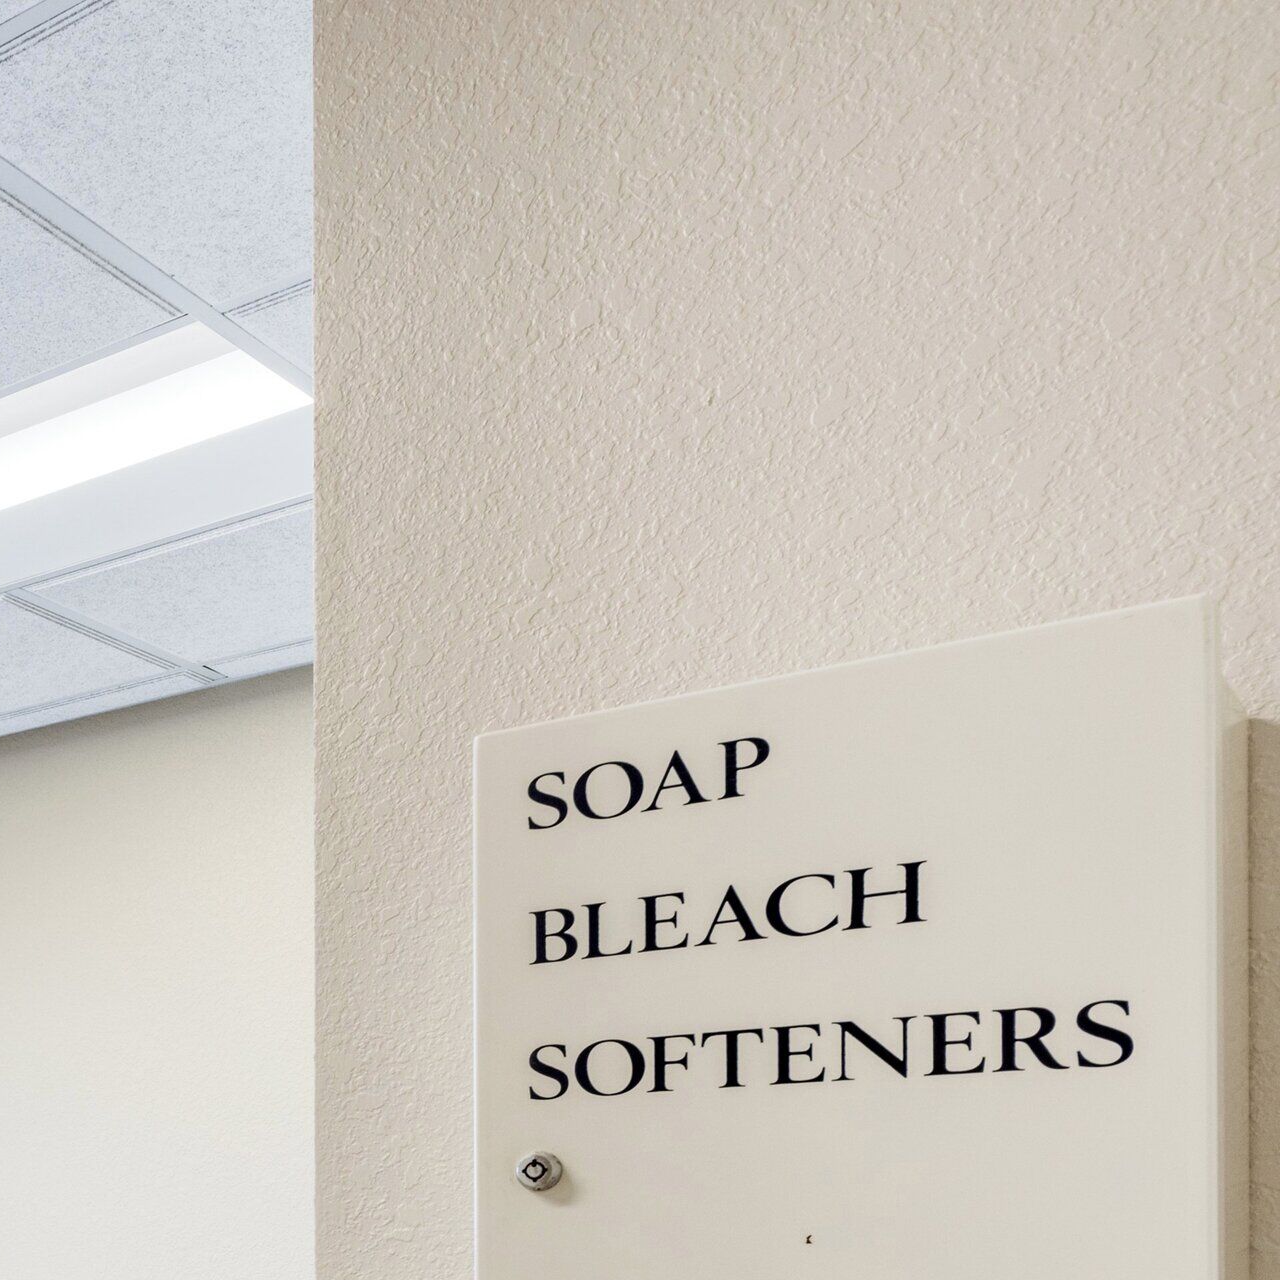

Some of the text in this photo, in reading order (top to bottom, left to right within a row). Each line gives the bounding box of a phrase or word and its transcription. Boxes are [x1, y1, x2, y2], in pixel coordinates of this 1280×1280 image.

[527, 736, 771, 831] SOAP
[528, 860, 928, 966] BLEACH
[528, 999, 1134, 1101] SOFTENERS
